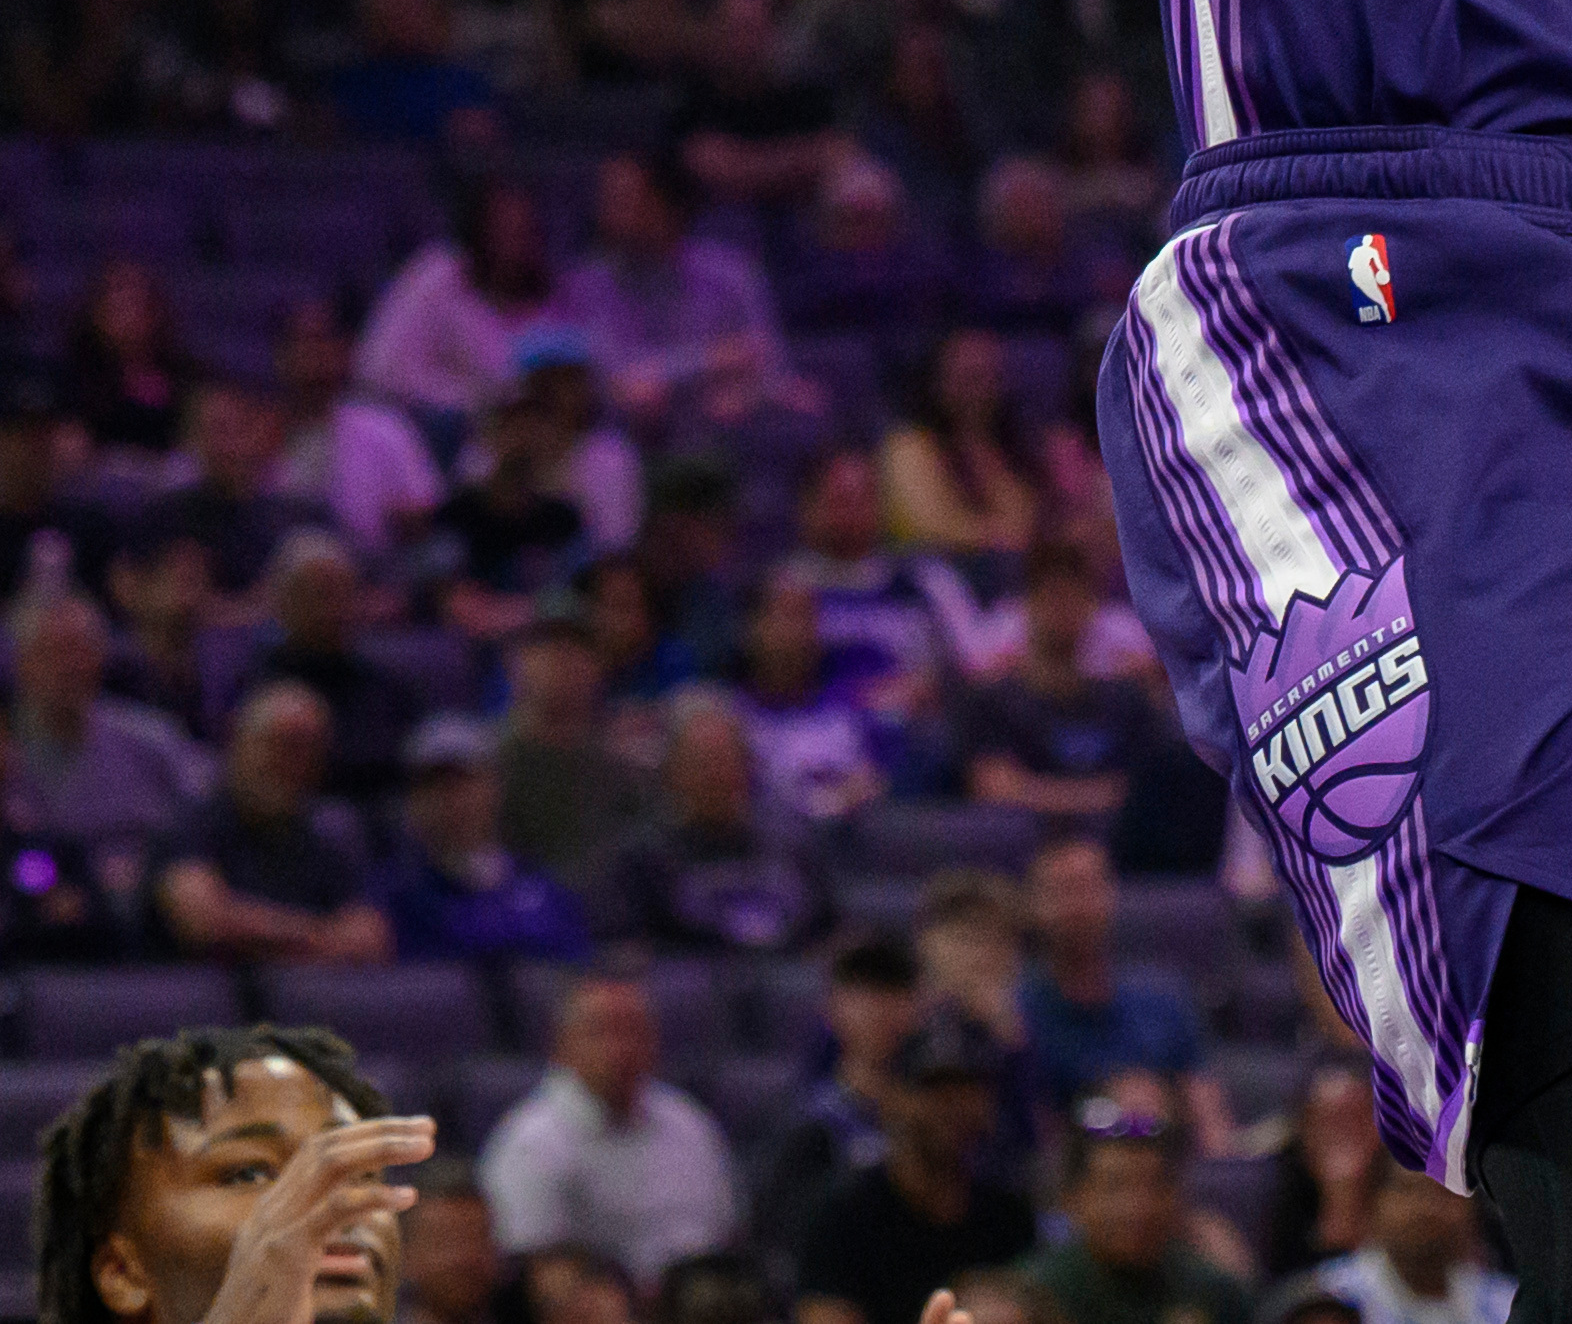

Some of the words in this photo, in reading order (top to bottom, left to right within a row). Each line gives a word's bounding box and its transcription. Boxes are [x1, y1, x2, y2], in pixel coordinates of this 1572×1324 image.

[1358, 304, 1381, 323] NBA
[1247, 616, 1408, 741] SACRAMENTO
[1252, 635, 1429, 804] KINGS
